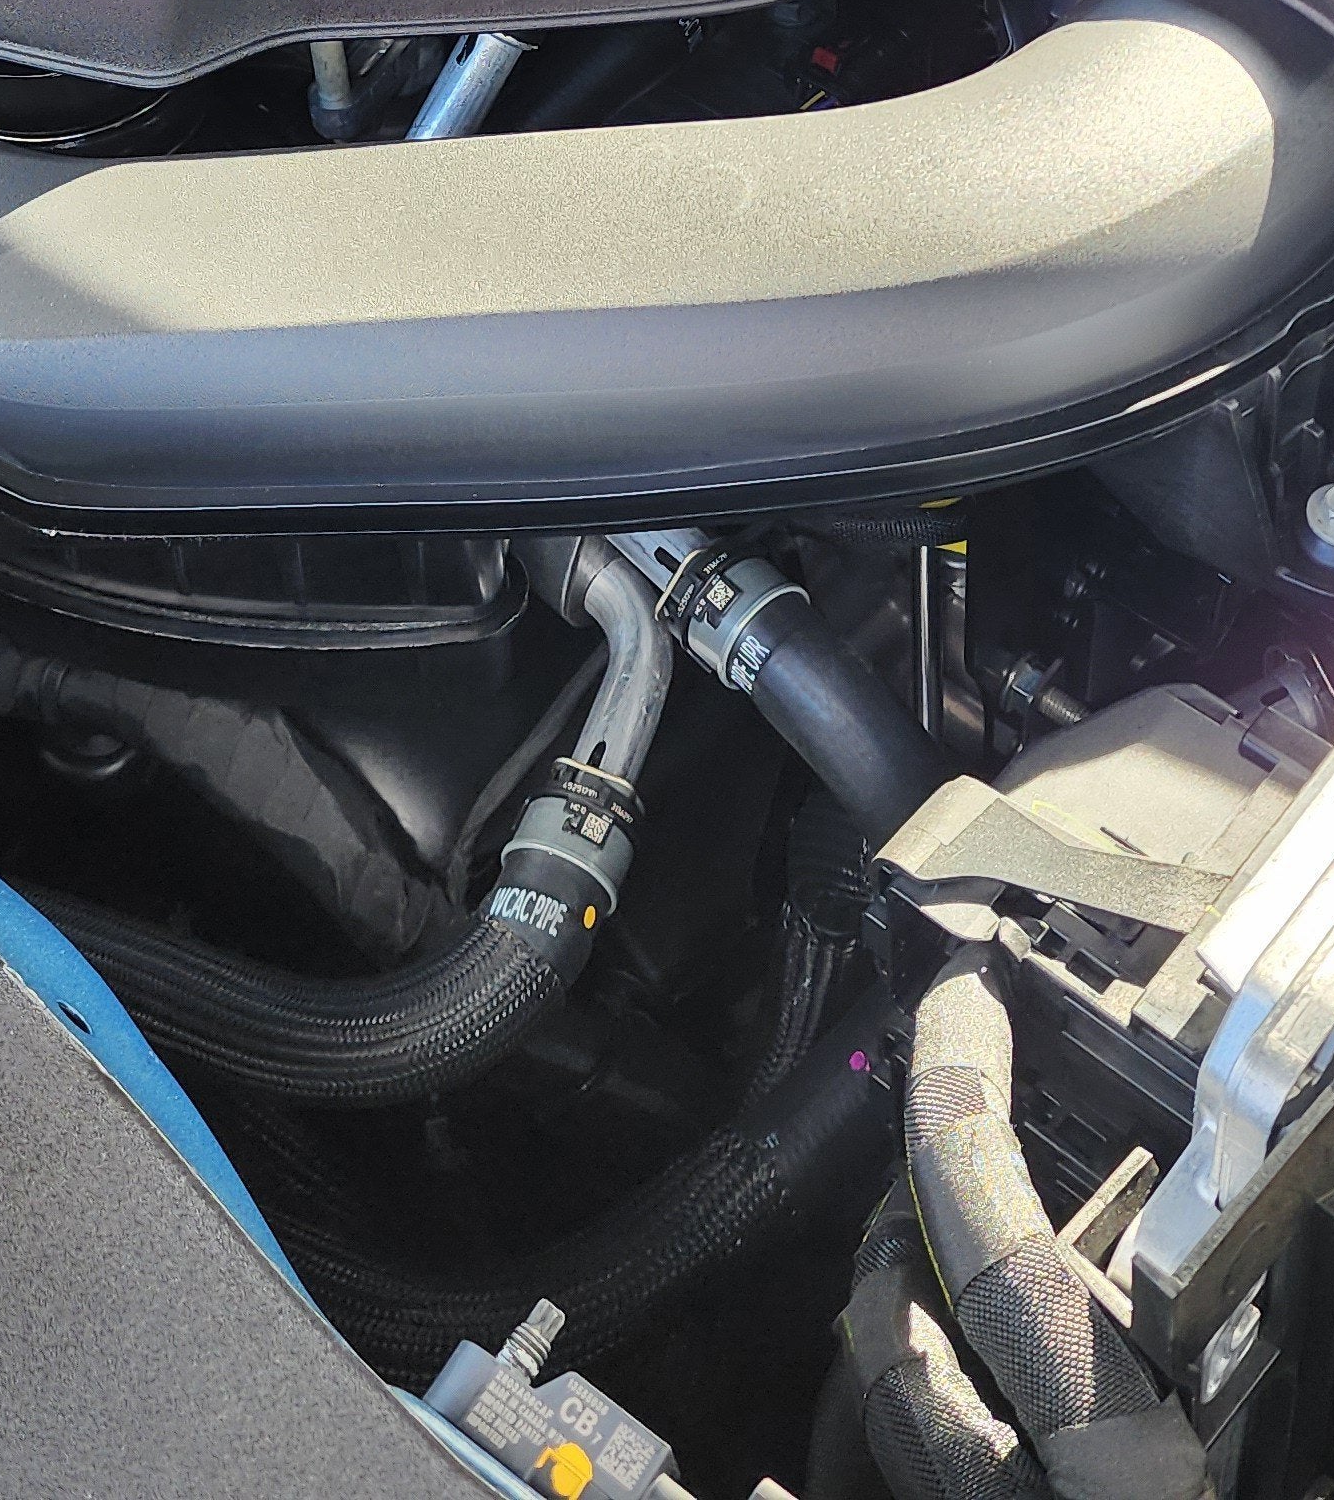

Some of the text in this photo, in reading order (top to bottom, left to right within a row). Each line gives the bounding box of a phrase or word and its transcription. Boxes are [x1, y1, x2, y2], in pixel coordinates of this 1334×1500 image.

[740, 635, 770, 673] UPR
[528, 893, 568, 937] PIPE
[559, 1396, 599, 1437] CB
